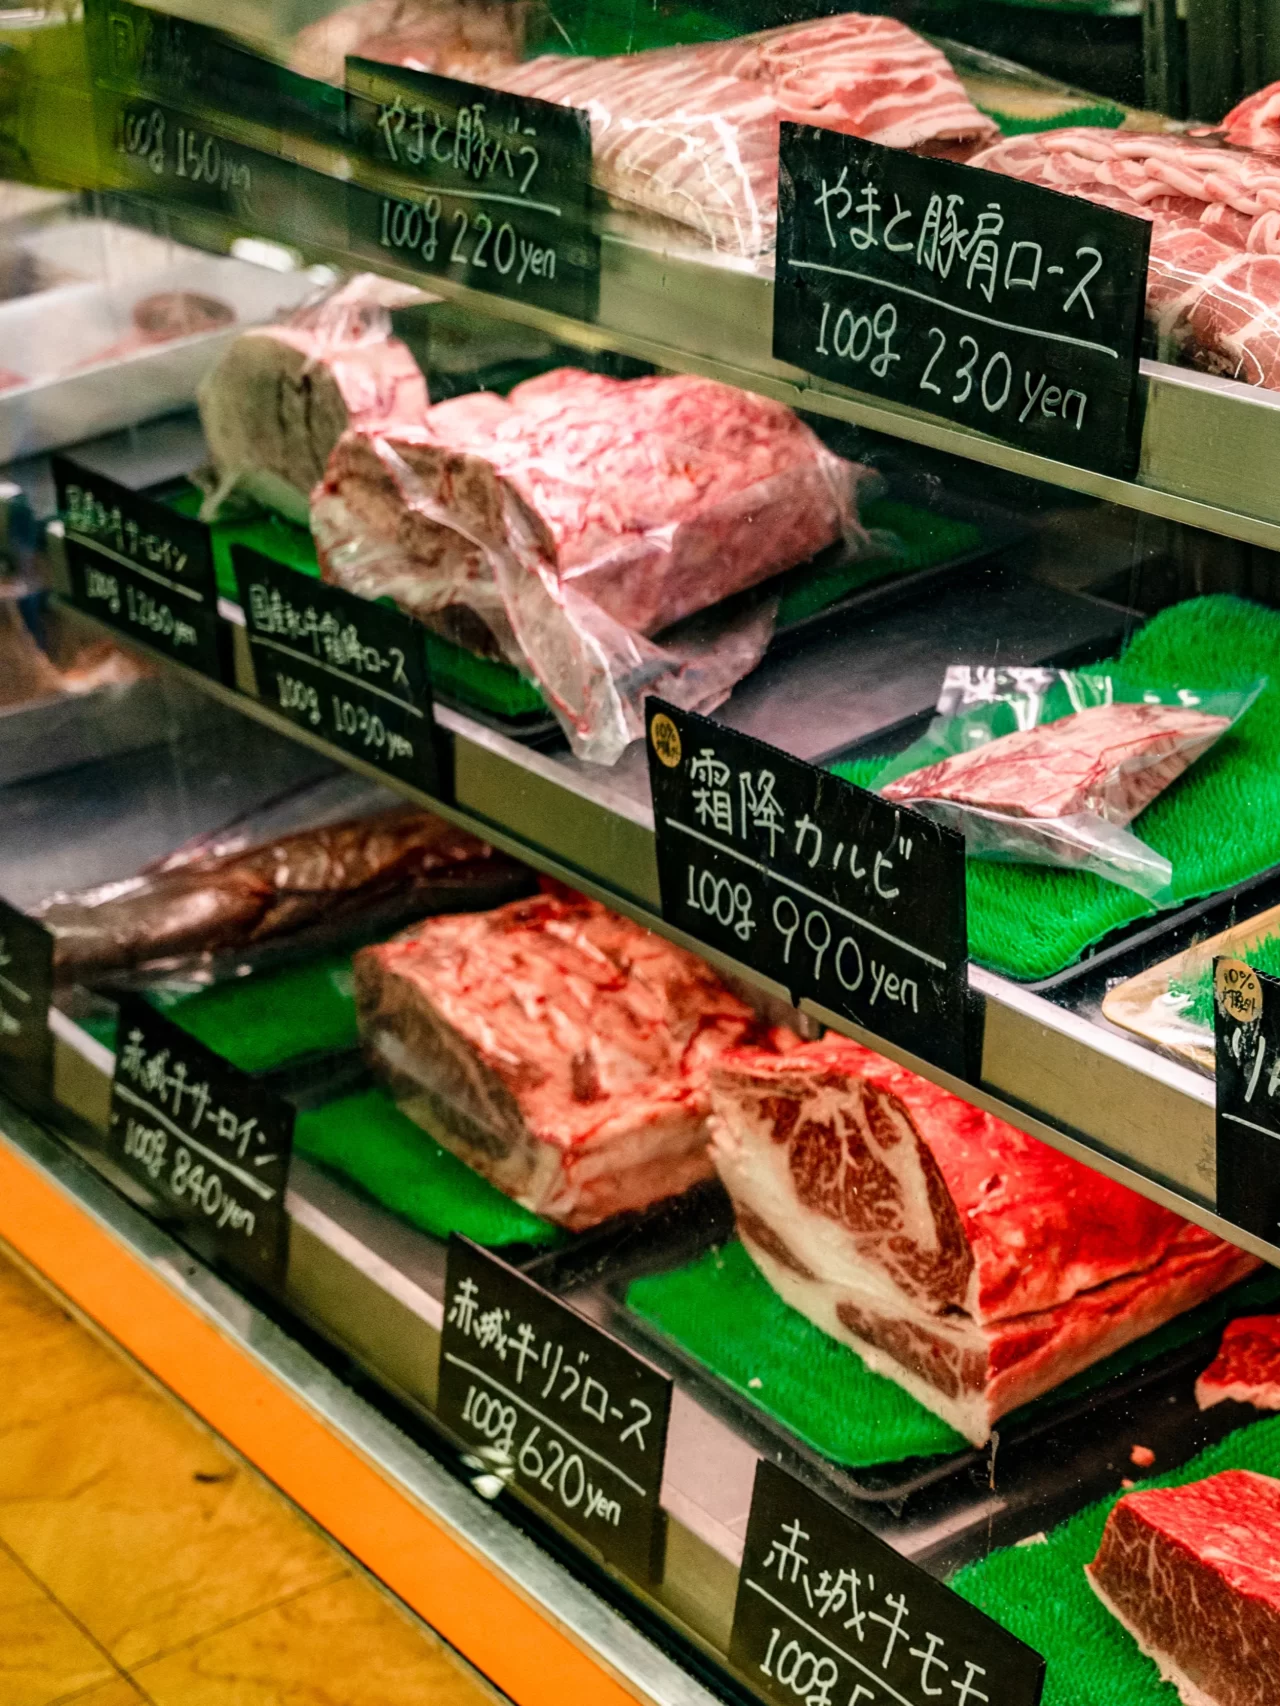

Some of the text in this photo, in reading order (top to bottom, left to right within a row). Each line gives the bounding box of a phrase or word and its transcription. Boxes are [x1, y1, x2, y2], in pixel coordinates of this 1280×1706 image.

[380, 196, 441, 262] 100g
[814, 166, 1103, 319] やまと豚肩ロース
[816, 302, 901, 377] 100g
[690, 748, 912, 899] 霜降カルビ
[686, 865, 756, 940] 100g
[1224, 968, 1255, 990] 10%
[124, 1118, 167, 1178] 100g
[447, 1278, 651, 1450] 赤城牛リブロース
[461, 1386, 517, 1454] 100g
[760, 1628, 838, 1706] 100g
